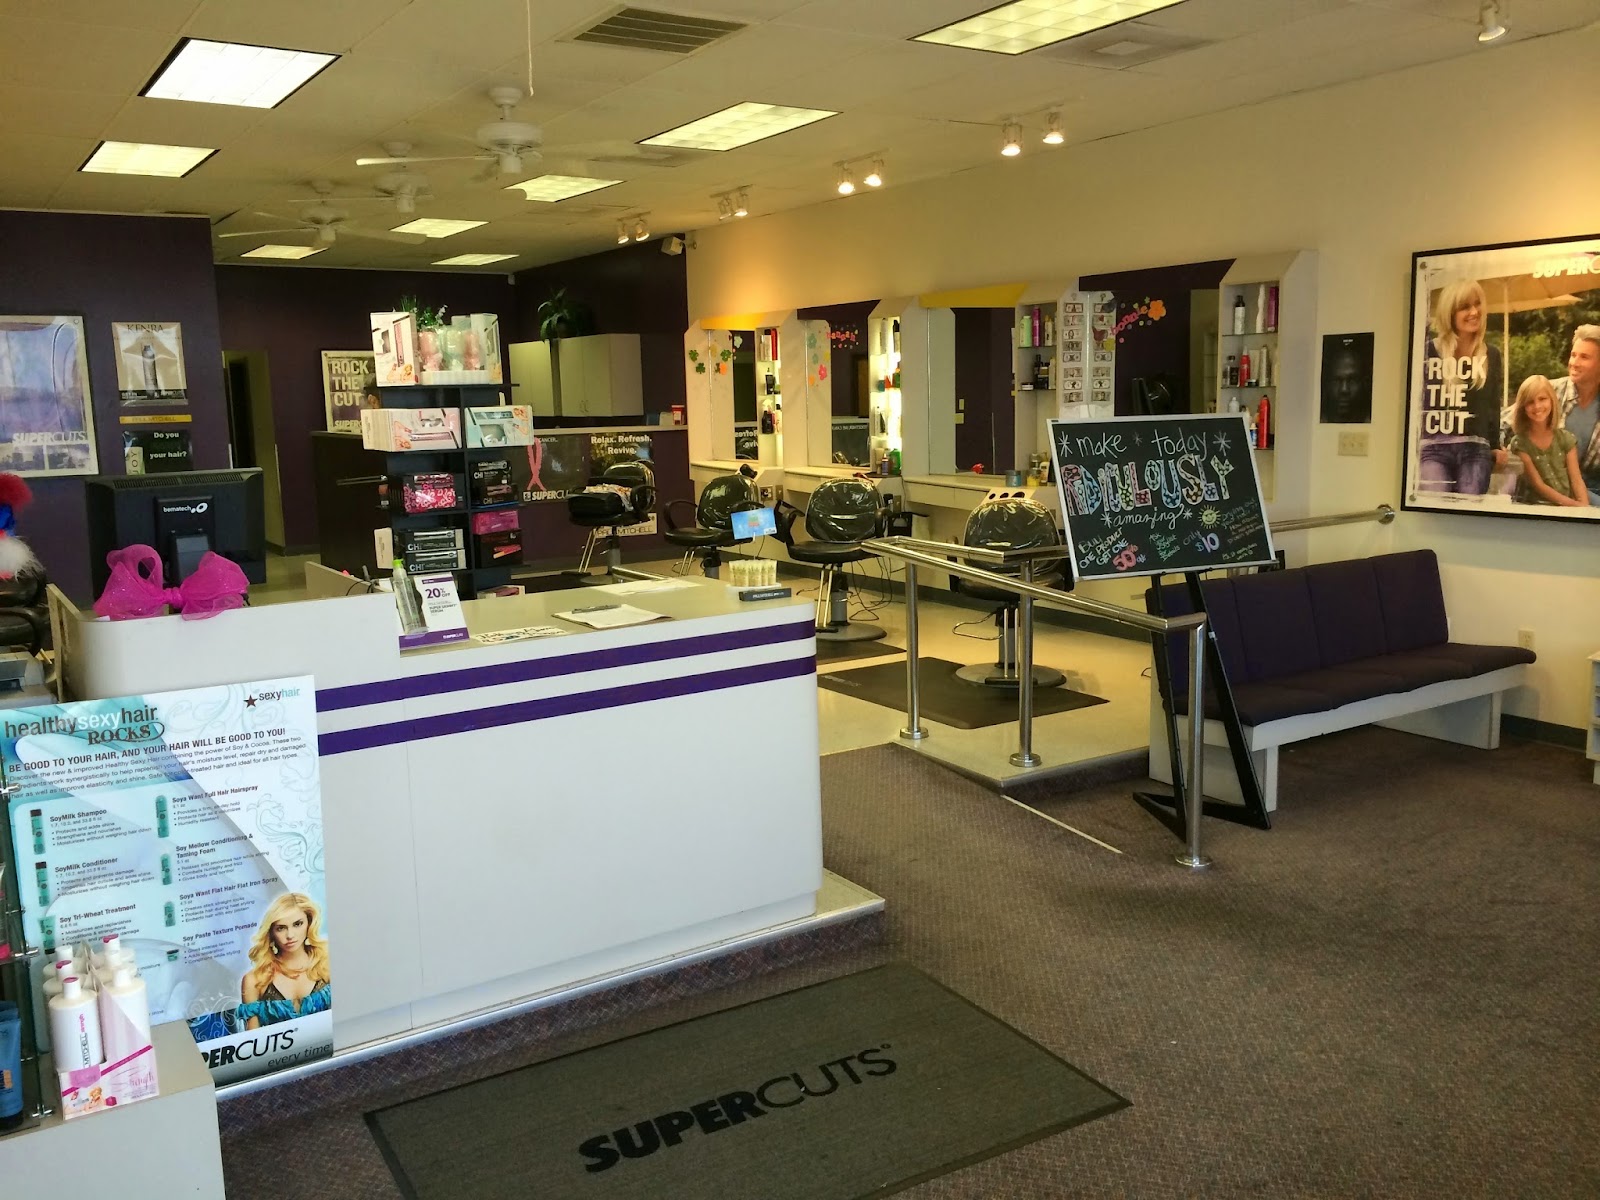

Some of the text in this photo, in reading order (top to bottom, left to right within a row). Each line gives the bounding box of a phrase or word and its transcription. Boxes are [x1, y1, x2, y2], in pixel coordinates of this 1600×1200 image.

[331, 360, 370, 375] ROCK
[1427, 355, 1487, 380] ROCK
[332, 376, 360, 390] THE
[334, 392, 362, 406] CUT
[1426, 384, 1467, 407] THE
[1425, 411, 1471, 434] CUT
[12, 431, 86, 445] SUPERCUTS
[591, 434, 652, 444] Relax. Refresh.
[1076, 427, 1207, 461] make today
[150, 450, 187, 460] your hair?
[608, 446, 636, 455] Revive.
[1113, 504, 1184, 529] amazing
[1096, 527, 1123, 555] PRODUCT
[1195, 532, 1220, 553] $10
[1096, 538, 1129, 566] GET ONE
[88, 724, 151, 745] ROCKS
[9, 728, 286, 772] BE GOOD TO YOUR HAIR, AND YOUR HAIR WILL BE GOOD TO YOU!
[230, 786, 258, 795] Hairspray
[50, 808, 107, 823] SoyMilk Shampoo
[188, 841, 210, 850] Mellow
[211, 835, 248, 846] Conditioning
[176, 850, 198, 860] Taming
[55, 858, 118, 874] SoyMilk Conditioner
[262, 876, 278, 886] Spray
[60, 904, 136, 924] Soy Tri-Wheat Treatment
[182, 922, 258, 944] Soy Paste Texture Pomade
[268, 1043, 332, 1069] every time
[578, 1048, 896, 1173] SUPERCUTS
